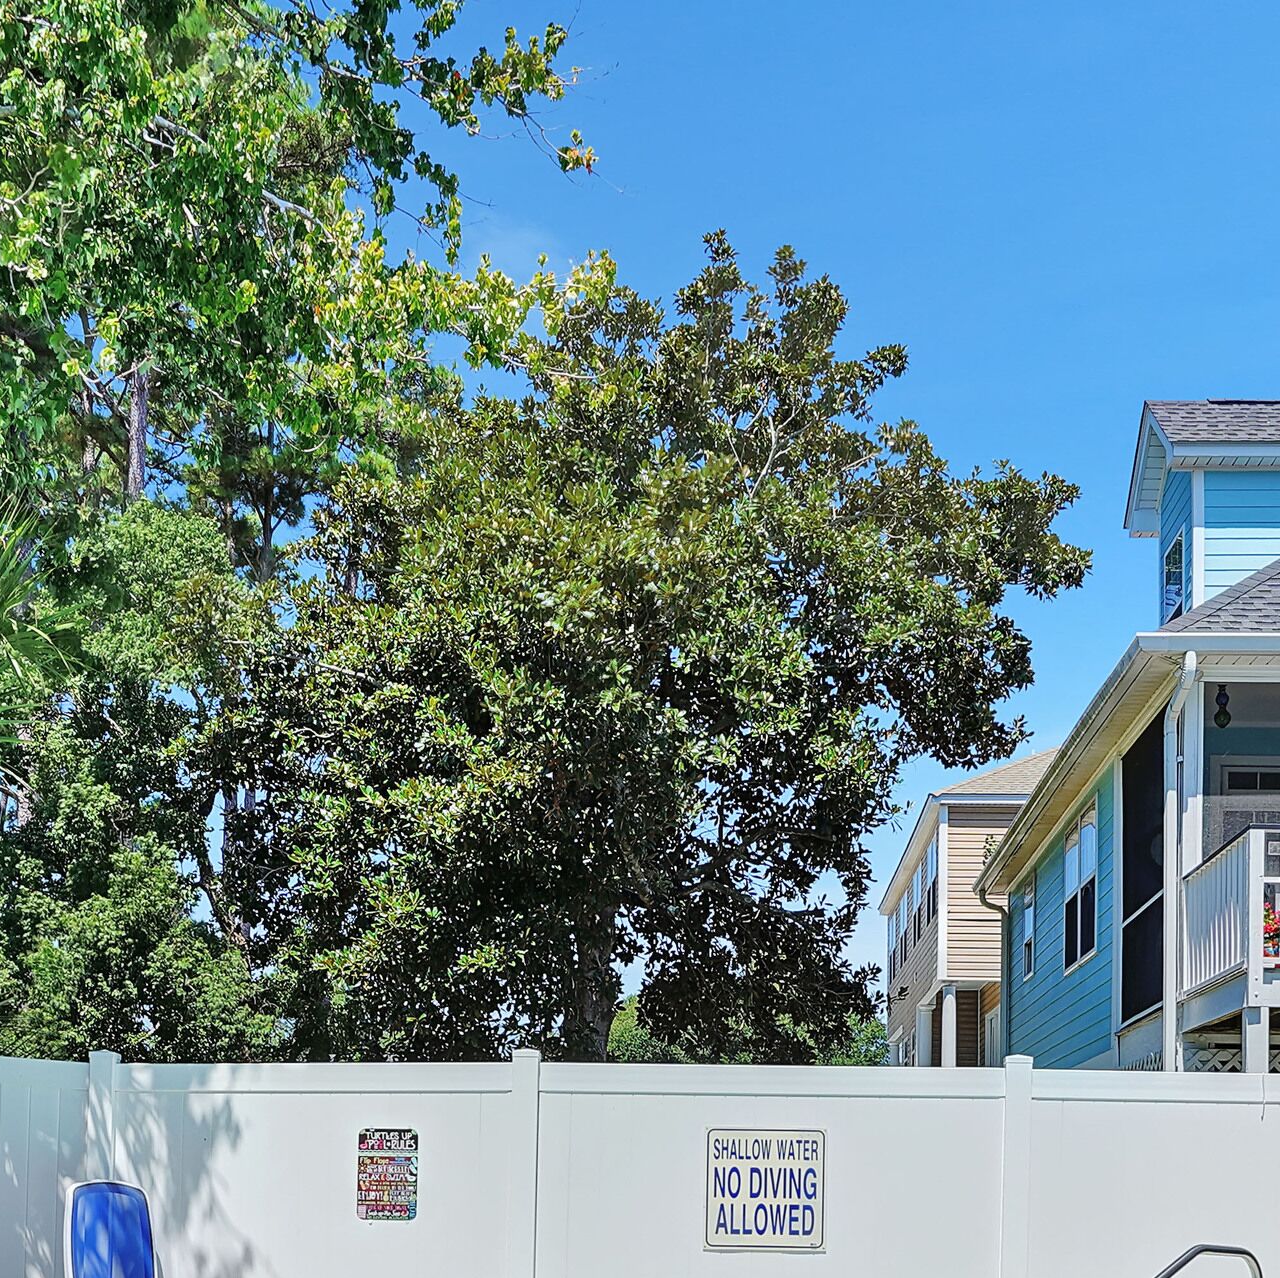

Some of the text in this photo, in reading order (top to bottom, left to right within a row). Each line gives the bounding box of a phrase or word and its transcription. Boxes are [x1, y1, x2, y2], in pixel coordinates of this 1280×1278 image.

[366, 1132, 413, 1140] TURTLES UP
[391, 1139, 416, 1150] RULES
[713, 1138, 819, 1161] SHALLOW WATER
[359, 1173, 380, 1181] RELAX
[713, 1166, 817, 1200] NO DIVING
[715, 1203, 815, 1236] ALLOWED
